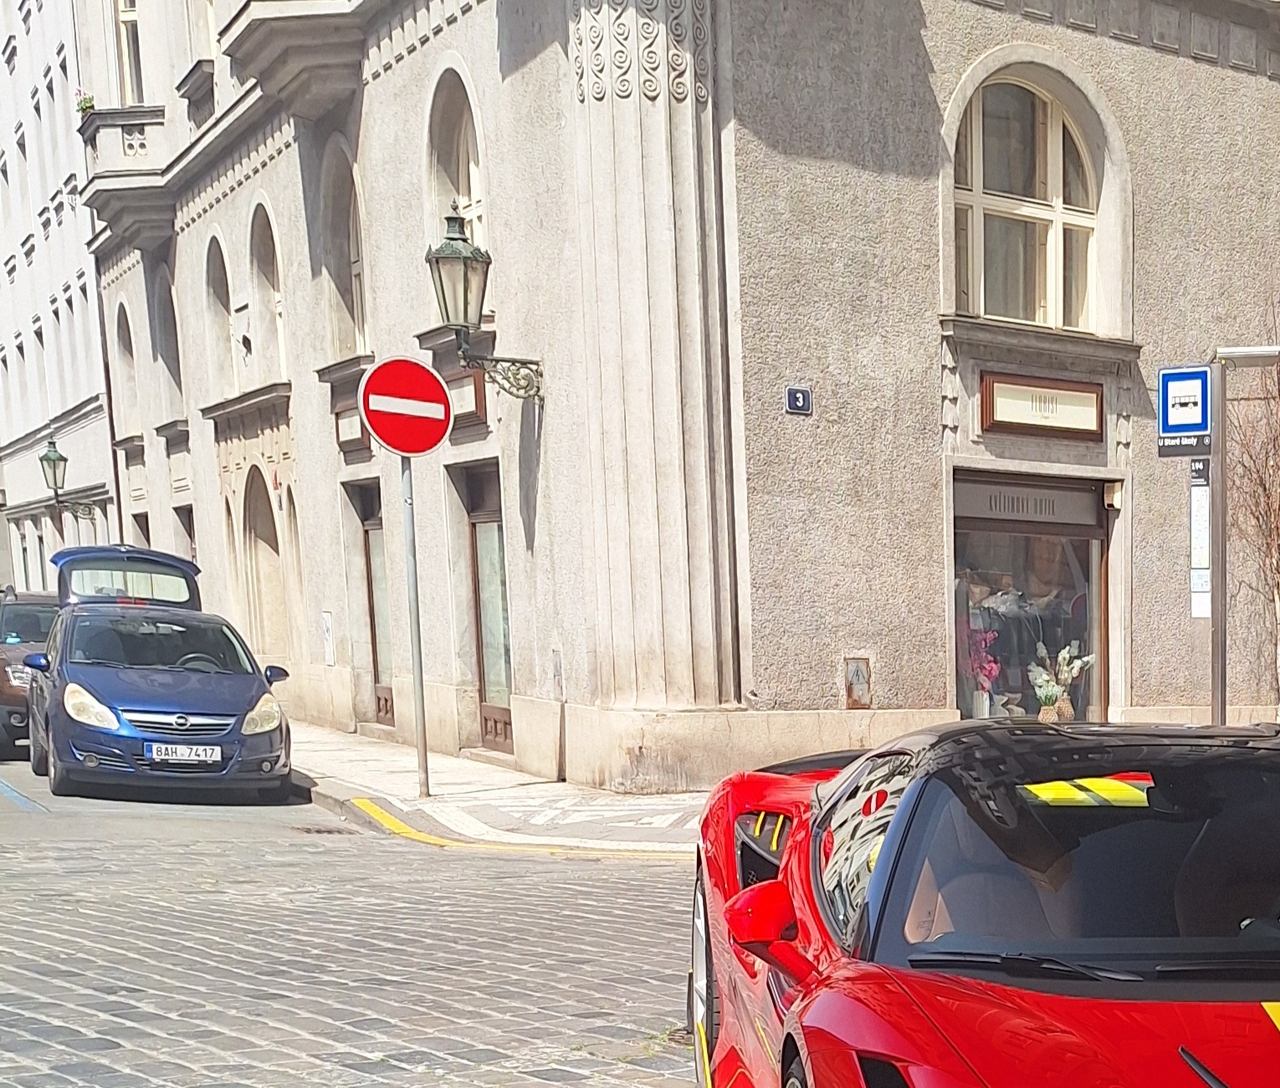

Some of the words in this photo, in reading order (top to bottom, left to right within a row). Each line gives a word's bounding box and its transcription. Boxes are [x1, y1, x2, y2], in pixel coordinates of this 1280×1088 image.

[795, 392, 804, 407] 3
[1031, 393, 1058, 415] FLORIST
[1158, 438, 1164, 447] U
[155, 746, 178, 757] 8AH
[187, 746, 216, 759] 7417
